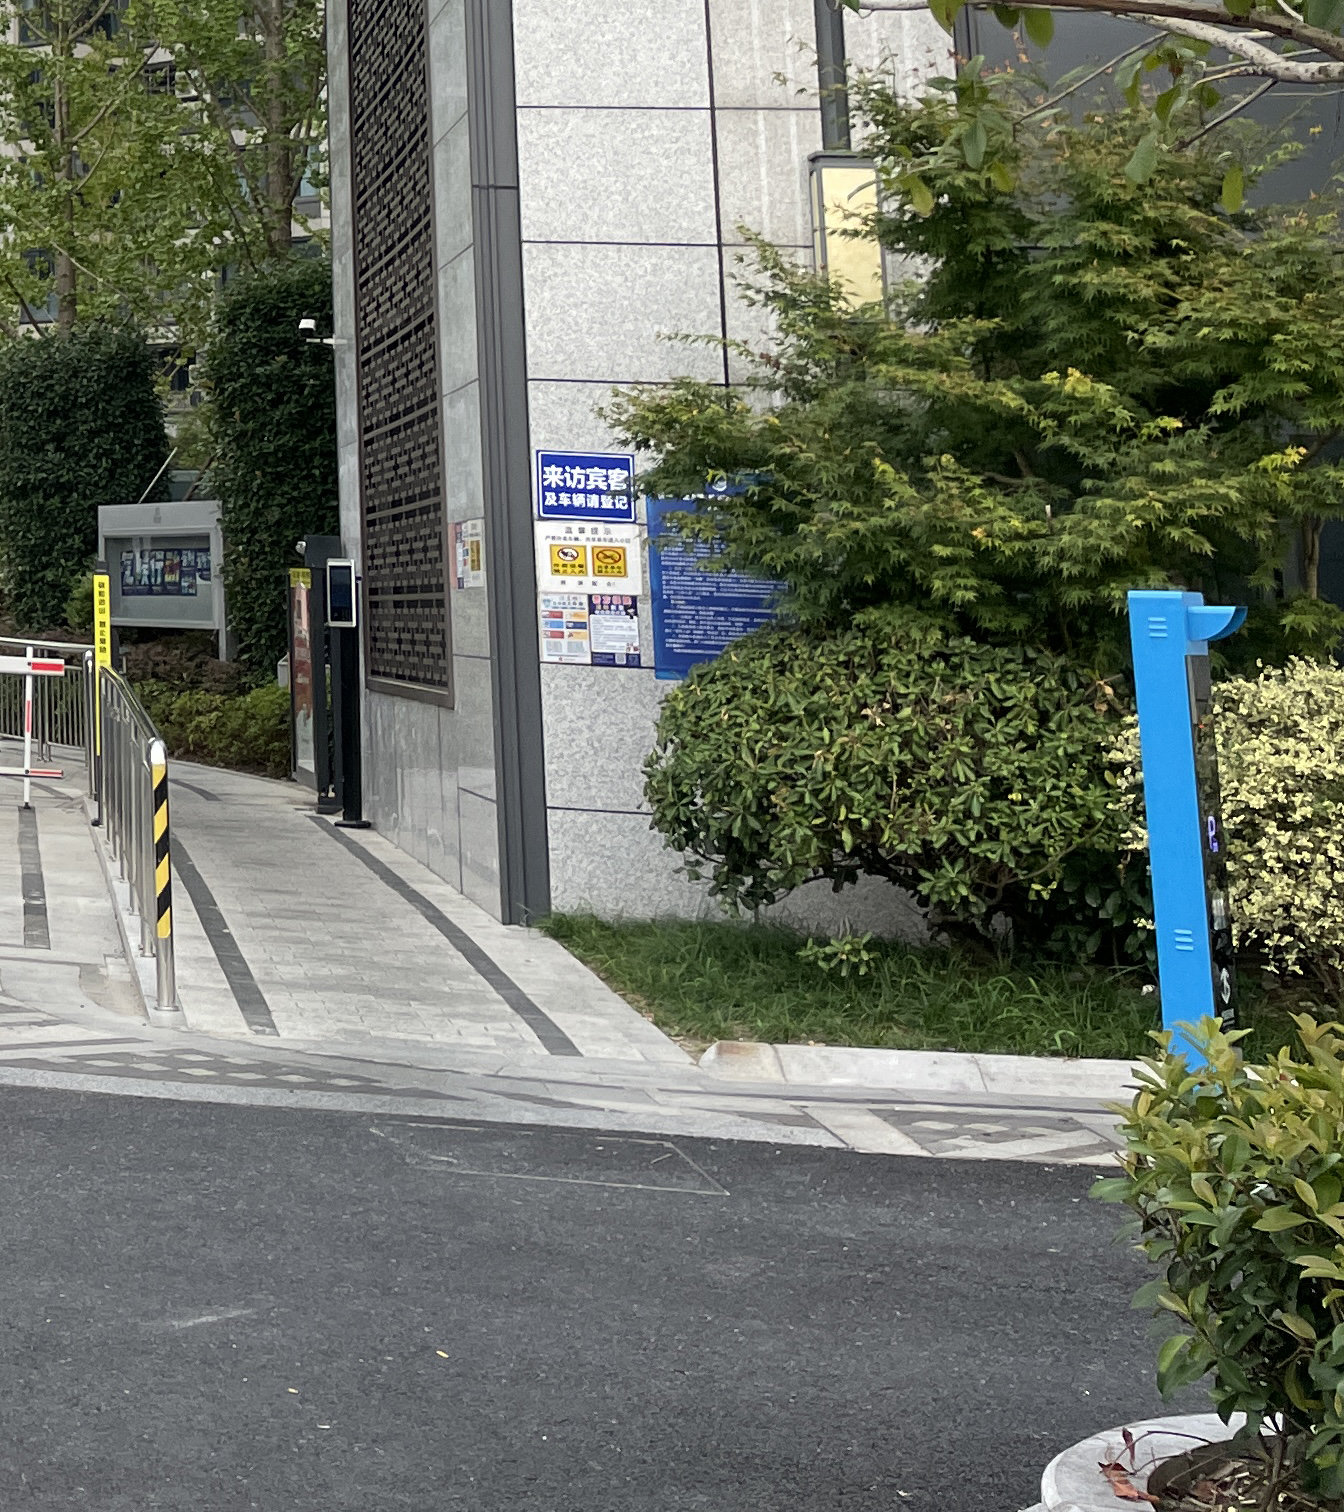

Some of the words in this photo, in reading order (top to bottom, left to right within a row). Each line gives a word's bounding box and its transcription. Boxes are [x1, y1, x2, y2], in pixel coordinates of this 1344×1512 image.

[542, 464, 630, 491] 来访宾客
[545, 491, 628, 510] 及车辆请登记
